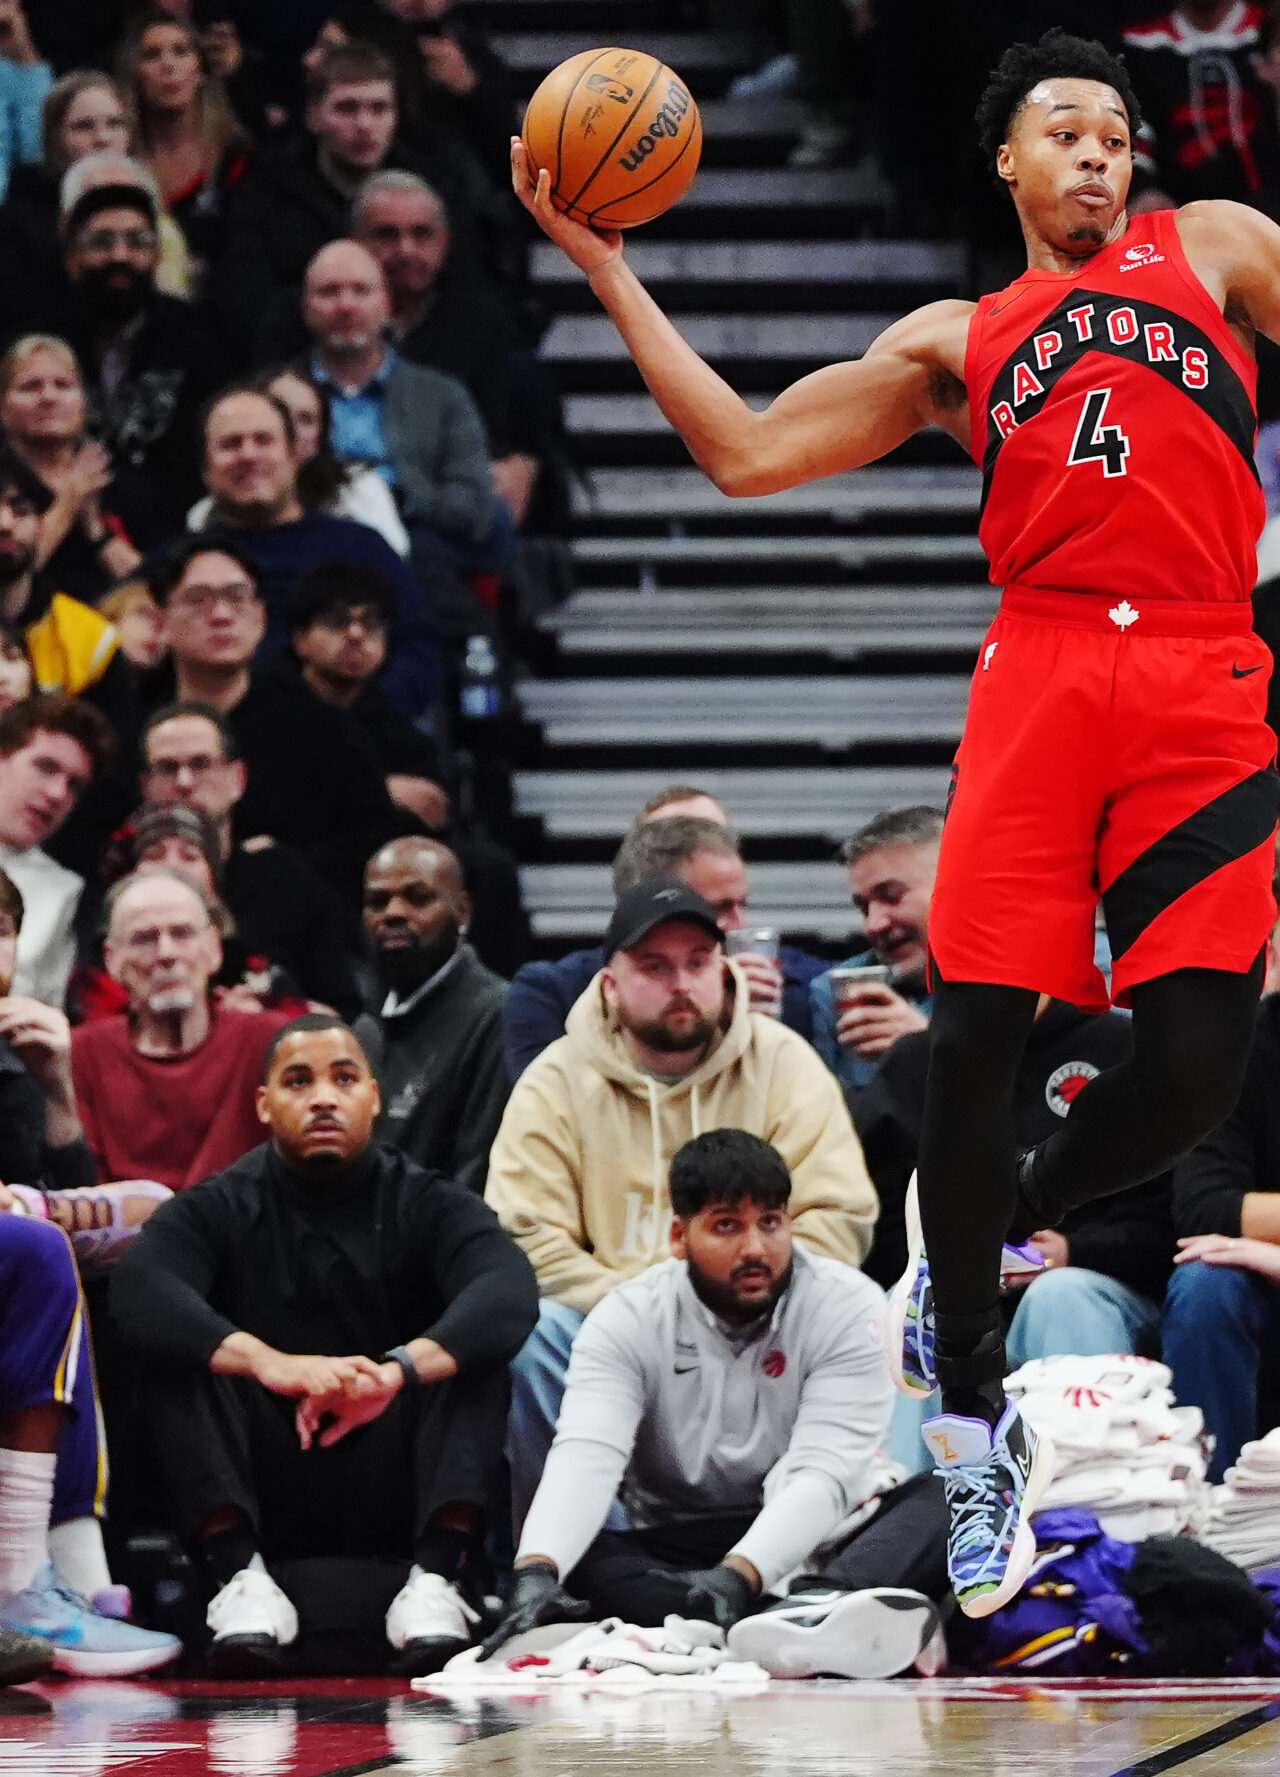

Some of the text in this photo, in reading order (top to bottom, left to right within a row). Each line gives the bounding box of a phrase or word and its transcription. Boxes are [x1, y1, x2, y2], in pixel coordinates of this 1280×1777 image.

[618, 80, 691, 172] Wilson
[1119, 254, 1165, 273] Sun Life
[990, 303, 1209, 439] RAPTORS
[1066, 387, 1131, 478] 4
